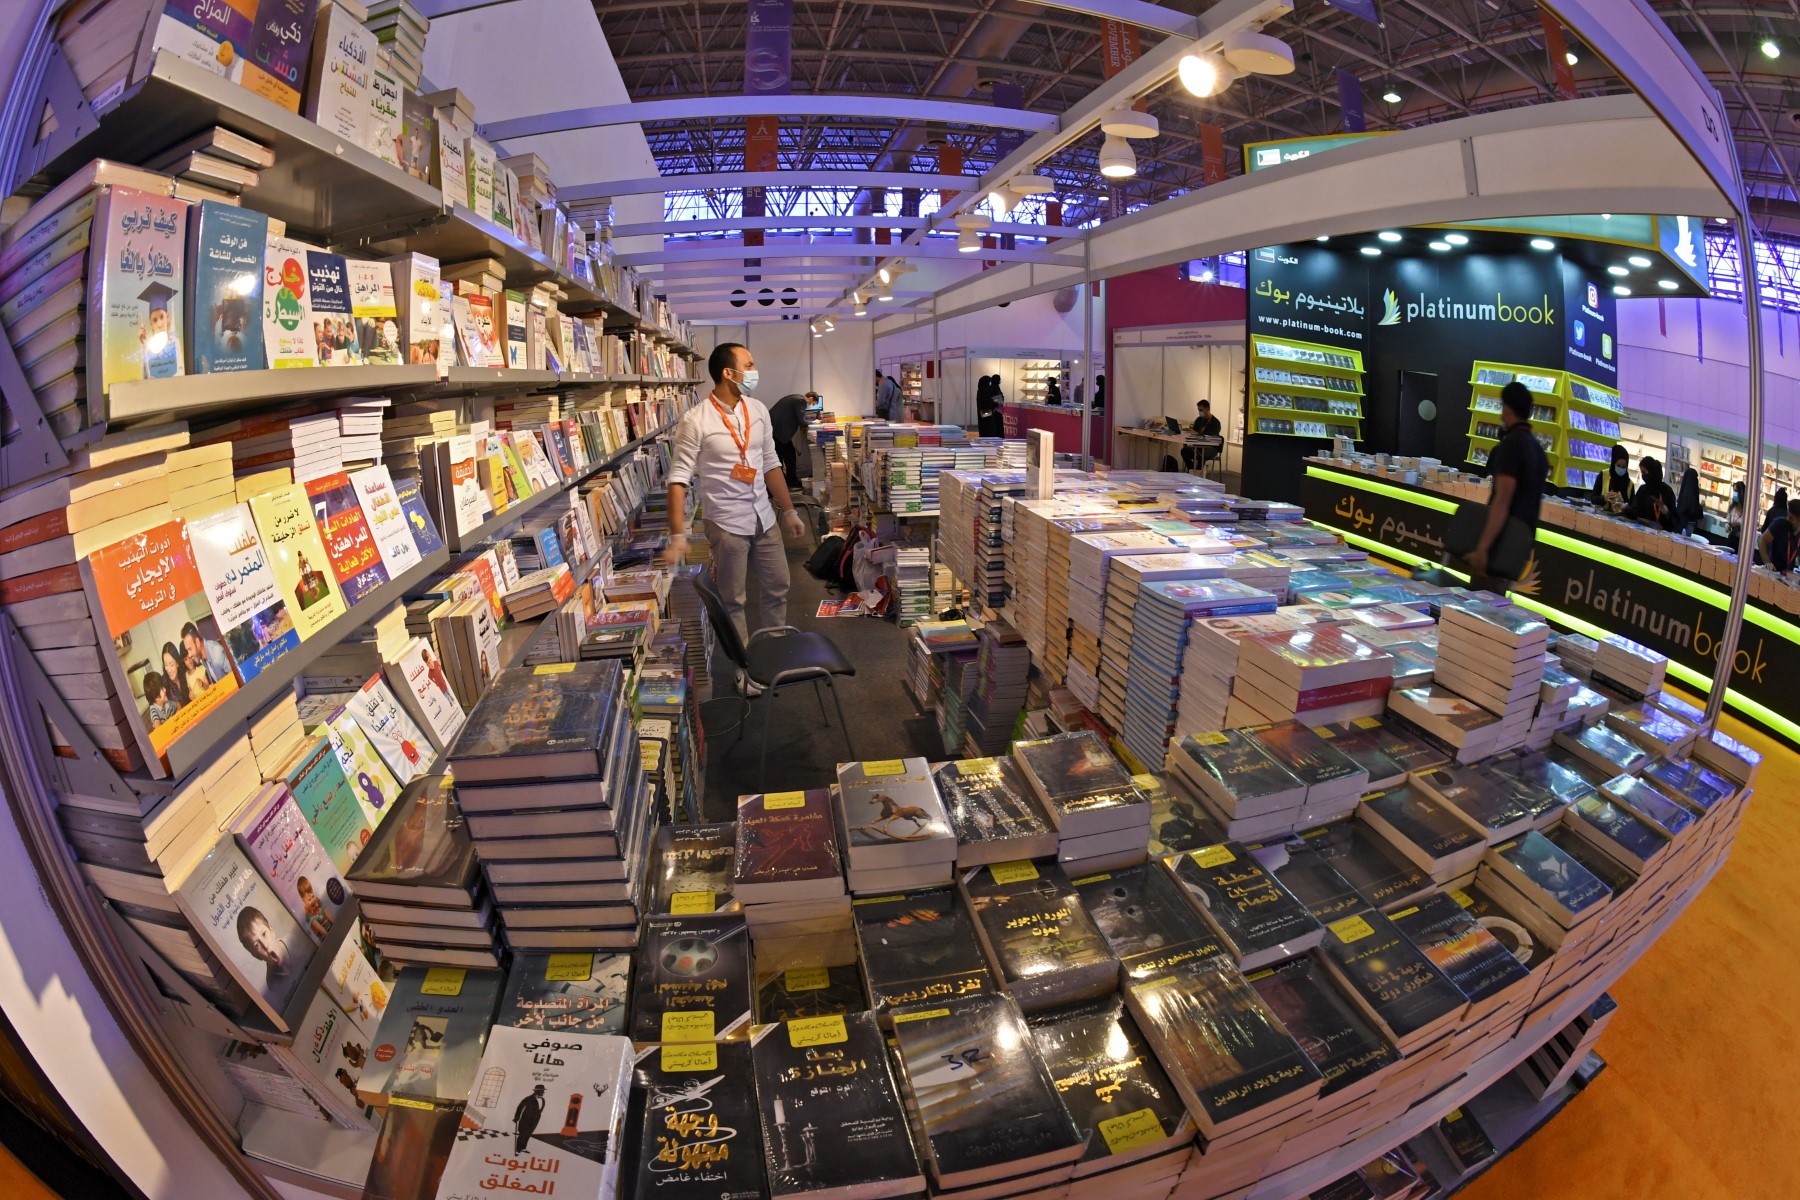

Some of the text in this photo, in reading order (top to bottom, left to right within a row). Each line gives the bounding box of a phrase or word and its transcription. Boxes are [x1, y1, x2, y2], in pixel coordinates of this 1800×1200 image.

[281, 22, 301, 45] ذكي
[339, 36, 367, 66] الأذكياء
[442, 135, 462, 157] مصيدة
[1283, 150, 1310, 160] الكويت
[121, 206, 177, 239] كيف تربي
[219, 234, 248, 250] فن الوقت
[208, 248, 257, 265] المخصص للشاشة
[1277, 254, 1299, 265] الكويت
[265, 265, 301, 287] خارج
[310, 264, 341, 282] تهذيب
[311, 283, 326, 293] التوتر
[325, 286, 334, 294] من
[355, 284, 380, 295] المراهق
[1255, 279, 1365, 320] بلاتينيوم بوك
[1406, 292, 1555, 326] platinumbook
[265, 300, 305, 326] السيطرة
[1258, 315, 1363, 339] www.platinum-book.com
[456, 461, 474, 479] الحقيقة
[365, 481, 387, 496] مساعدة
[274, 508, 300, 528] لا ضرر من
[341, 512, 361, 530] العادات
[1334, 495, 1375, 533] بوك
[272, 521, 311, 544] تسلق الزحليقة
[118, 534, 171, 571] أدوات التهذيب
[229, 530, 257, 556] طفلك
[329, 527, 369, 560] للمراهقين
[400, 543, 410, 555] بول
[231, 550, 265, 585] المتمرد
[339, 547, 375, 574] الأكثر فعالية
[126, 555, 176, 599] الإيجابي
[138, 583, 177, 612] في التربية
[410, 664, 425, 682] طفلك
[378, 691, 385, 704] لا
[417, 680, 432, 700] مزعج
[390, 703, 397, 720] كن
[209, 862, 238, 905] تغيير طفلك من
[1212, 866, 1263, 886] قطة
[1226, 878, 1273, 899] بين
[1237, 888, 1283, 913] الحمام
[212, 902, 226, 927] القبول
[1005, 907, 1072, 929] اللورد إدجوير
[1031, 925, 1060, 937] يموت
[1157, 956, 1167, 968] أن
[1168, 951, 1196, 966] تستطيع
[886, 977, 981, 1006] لغز الكاريبي
[1367, 975, 1390, 993] شارع
[1380, 986, 1401, 1002] دوك
[405, 1001, 465, 1016] العدو الخفي
[515, 996, 573, 1010] المتصدعة
[665, 994, 715, 1009] الخمسة
[547, 1013, 583, 1029] جانب
[585, 1016, 606, 1029] من
[522, 1038, 584, 1054] صوفي
[796, 1030, 841, 1044] أجاثا كريستي
[532, 1052, 565, 1067] هانا
[667, 1057, 713, 1071] أجاثا كريستي
[1352, 1044, 1390, 1071] أبجدية
[789, 1058, 868, 1082] الجنازة
[1278, 1064, 1305, 1081] جريمة
[809, 1085, 832, 1097] المتوقع
[664, 1105, 719, 1138] وجهة
[656, 1135, 730, 1171] مجهولة
[484, 1152, 561, 1175] التابوت
[478, 1172, 556, 1197] المغلق
[655, 1170, 728, 1187] اختفاء غامض
